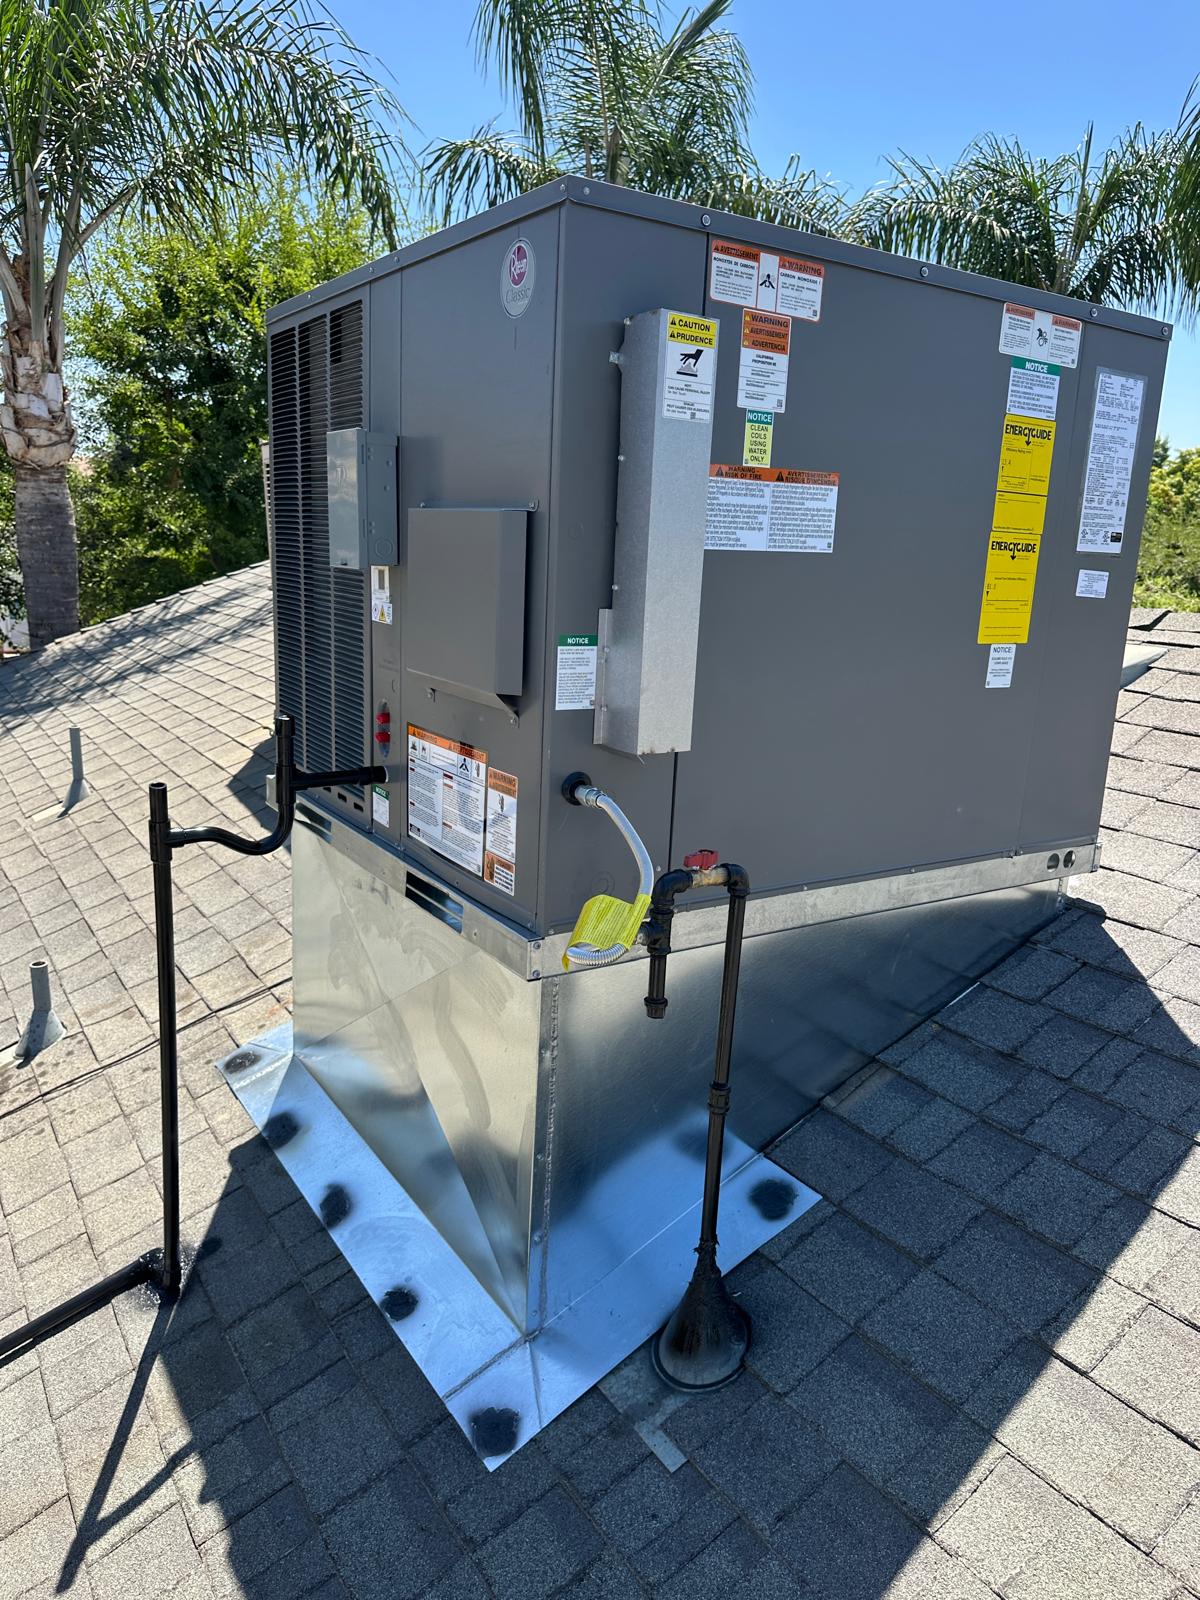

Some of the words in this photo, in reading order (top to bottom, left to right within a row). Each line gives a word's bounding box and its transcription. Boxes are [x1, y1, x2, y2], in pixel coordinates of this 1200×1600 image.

[787, 260, 822, 276] WARNING
[678, 318, 711, 332] CAUTION
[751, 314, 789, 328] WARNING
[676, 332, 713, 346] PRUDENCE
[751, 339, 786, 352] ADVERTENCIA
[1025, 361, 1049, 373] NOTICE
[748, 411, 772, 423] NOTICE
[750, 424, 769, 432] CLEAN
[1005, 423, 1052, 441] ENERGYGUIDE
[750, 432, 767, 440] COILS
[750, 440, 767, 448] USING
[749, 447, 767, 455] WATER
[750, 455, 765, 463] ONLY
[991, 540, 1037, 554] ENERGYGUIDE
[567, 637, 589, 645] NOTICE
